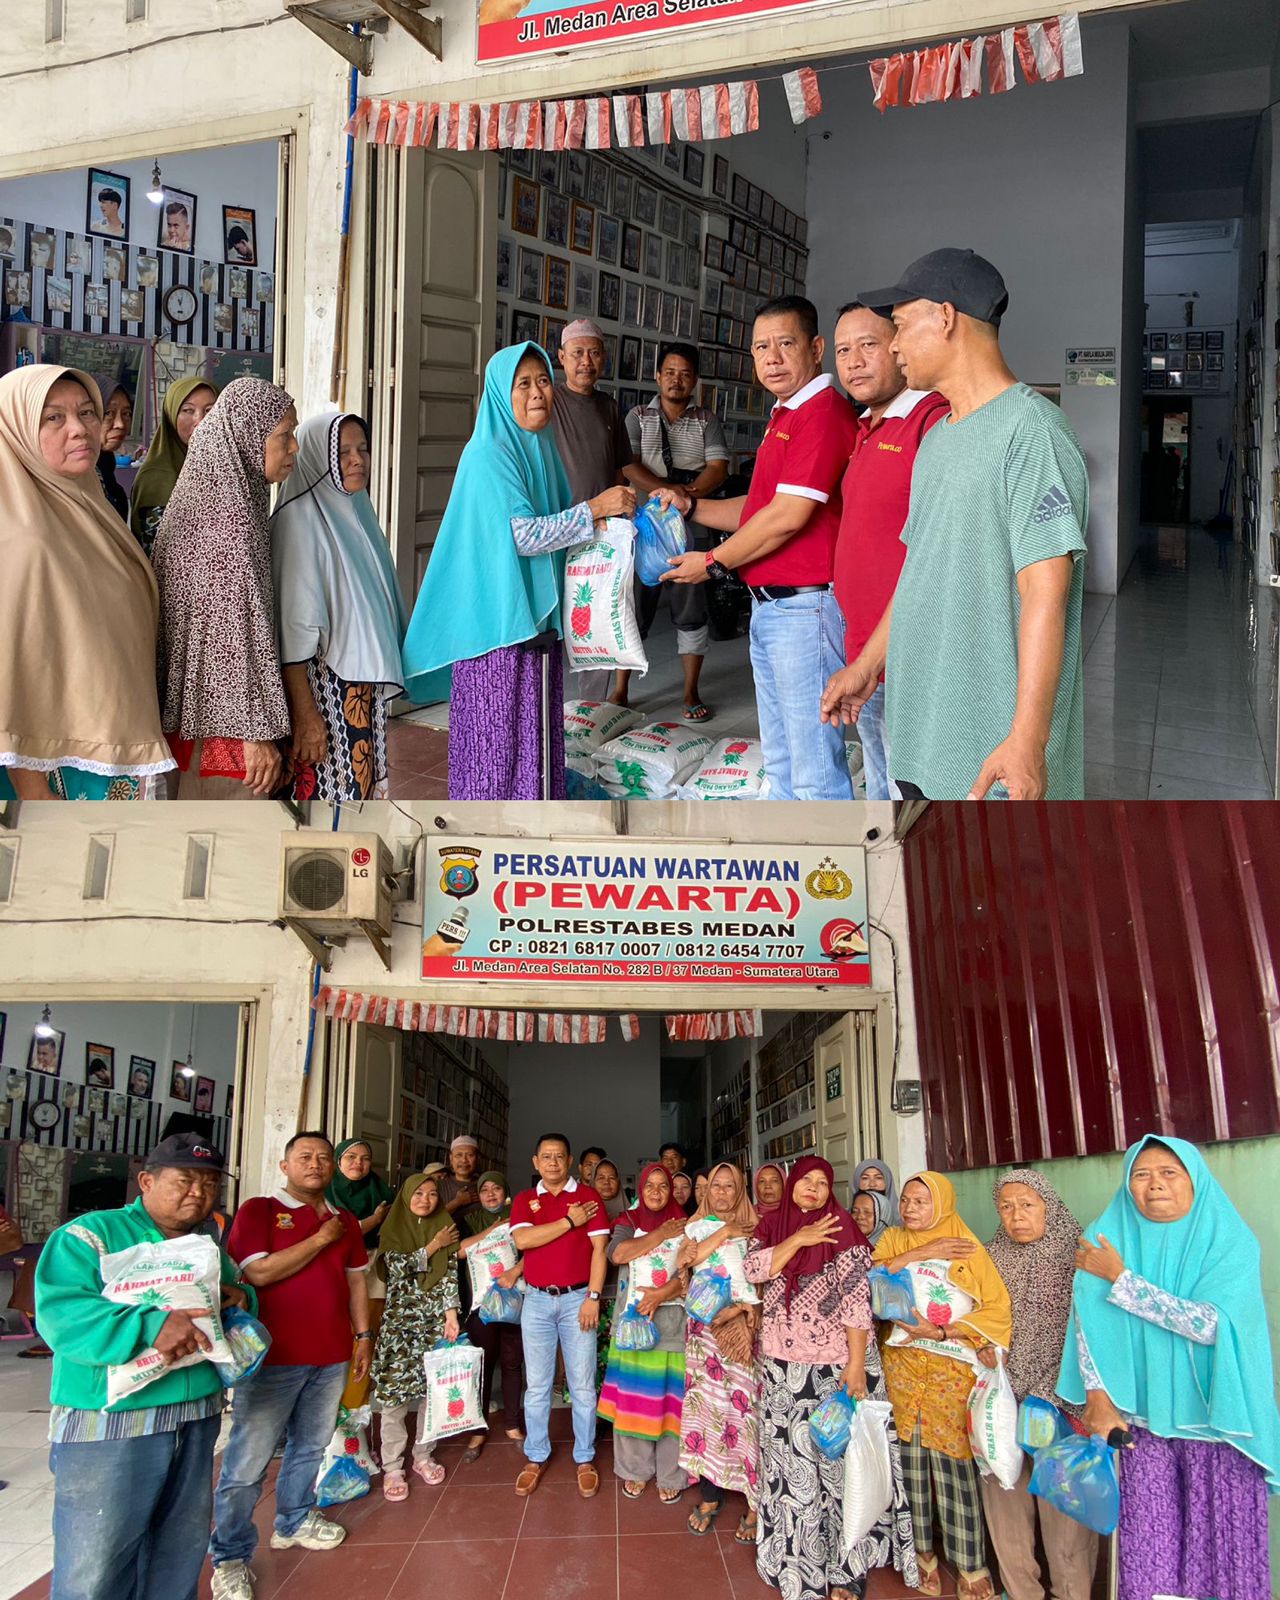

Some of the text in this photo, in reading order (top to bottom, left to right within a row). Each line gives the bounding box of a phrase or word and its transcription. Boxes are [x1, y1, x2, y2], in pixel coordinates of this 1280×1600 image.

[519, 23, 538, 40] Jl.
[546, 13, 605, 36] Medan
[612, 5, 657, 23] Area
[352, 868, 369, 878] LG
[493, 853, 800, 882] PERSATUAN WARTAWAN
[493, 880, 801, 920] (PEWARTA)
[442, 922, 458, 935] PERS
[499, 917, 796, 938] POLRESTABES MEDAN
[489, 940, 512, 953] CP
[528, 941, 568, 954] 0821
[575, 941, 616, 956] 6817
[621, 942, 661, 957] 0007
[675, 943, 716, 957] 0812
[720, 944, 761, 958] 6454
[765, 944, 805, 958] 7707
[453, 960, 469, 971] Jl.
[473, 961, 516, 973] Medan
[519, 962, 549, 973] Area
[552, 962, 599, 974] Selatan
[603, 964, 624, 975] No.
[628, 965, 650, 976] 282
[653, 965, 663, 976] B
[673, 965, 688, 976] 37
[691, 965, 732, 977] Medan
[744, 965, 802, 978] Sumatera
[806, 966, 839, 977] Utara
[114, 1278, 163, 1293] RAHMAT
[930, 1342, 963, 1354] TERBAIK
[136, 1352, 163, 1368] BRUT
[985, 1432, 997, 1461] BERAS
